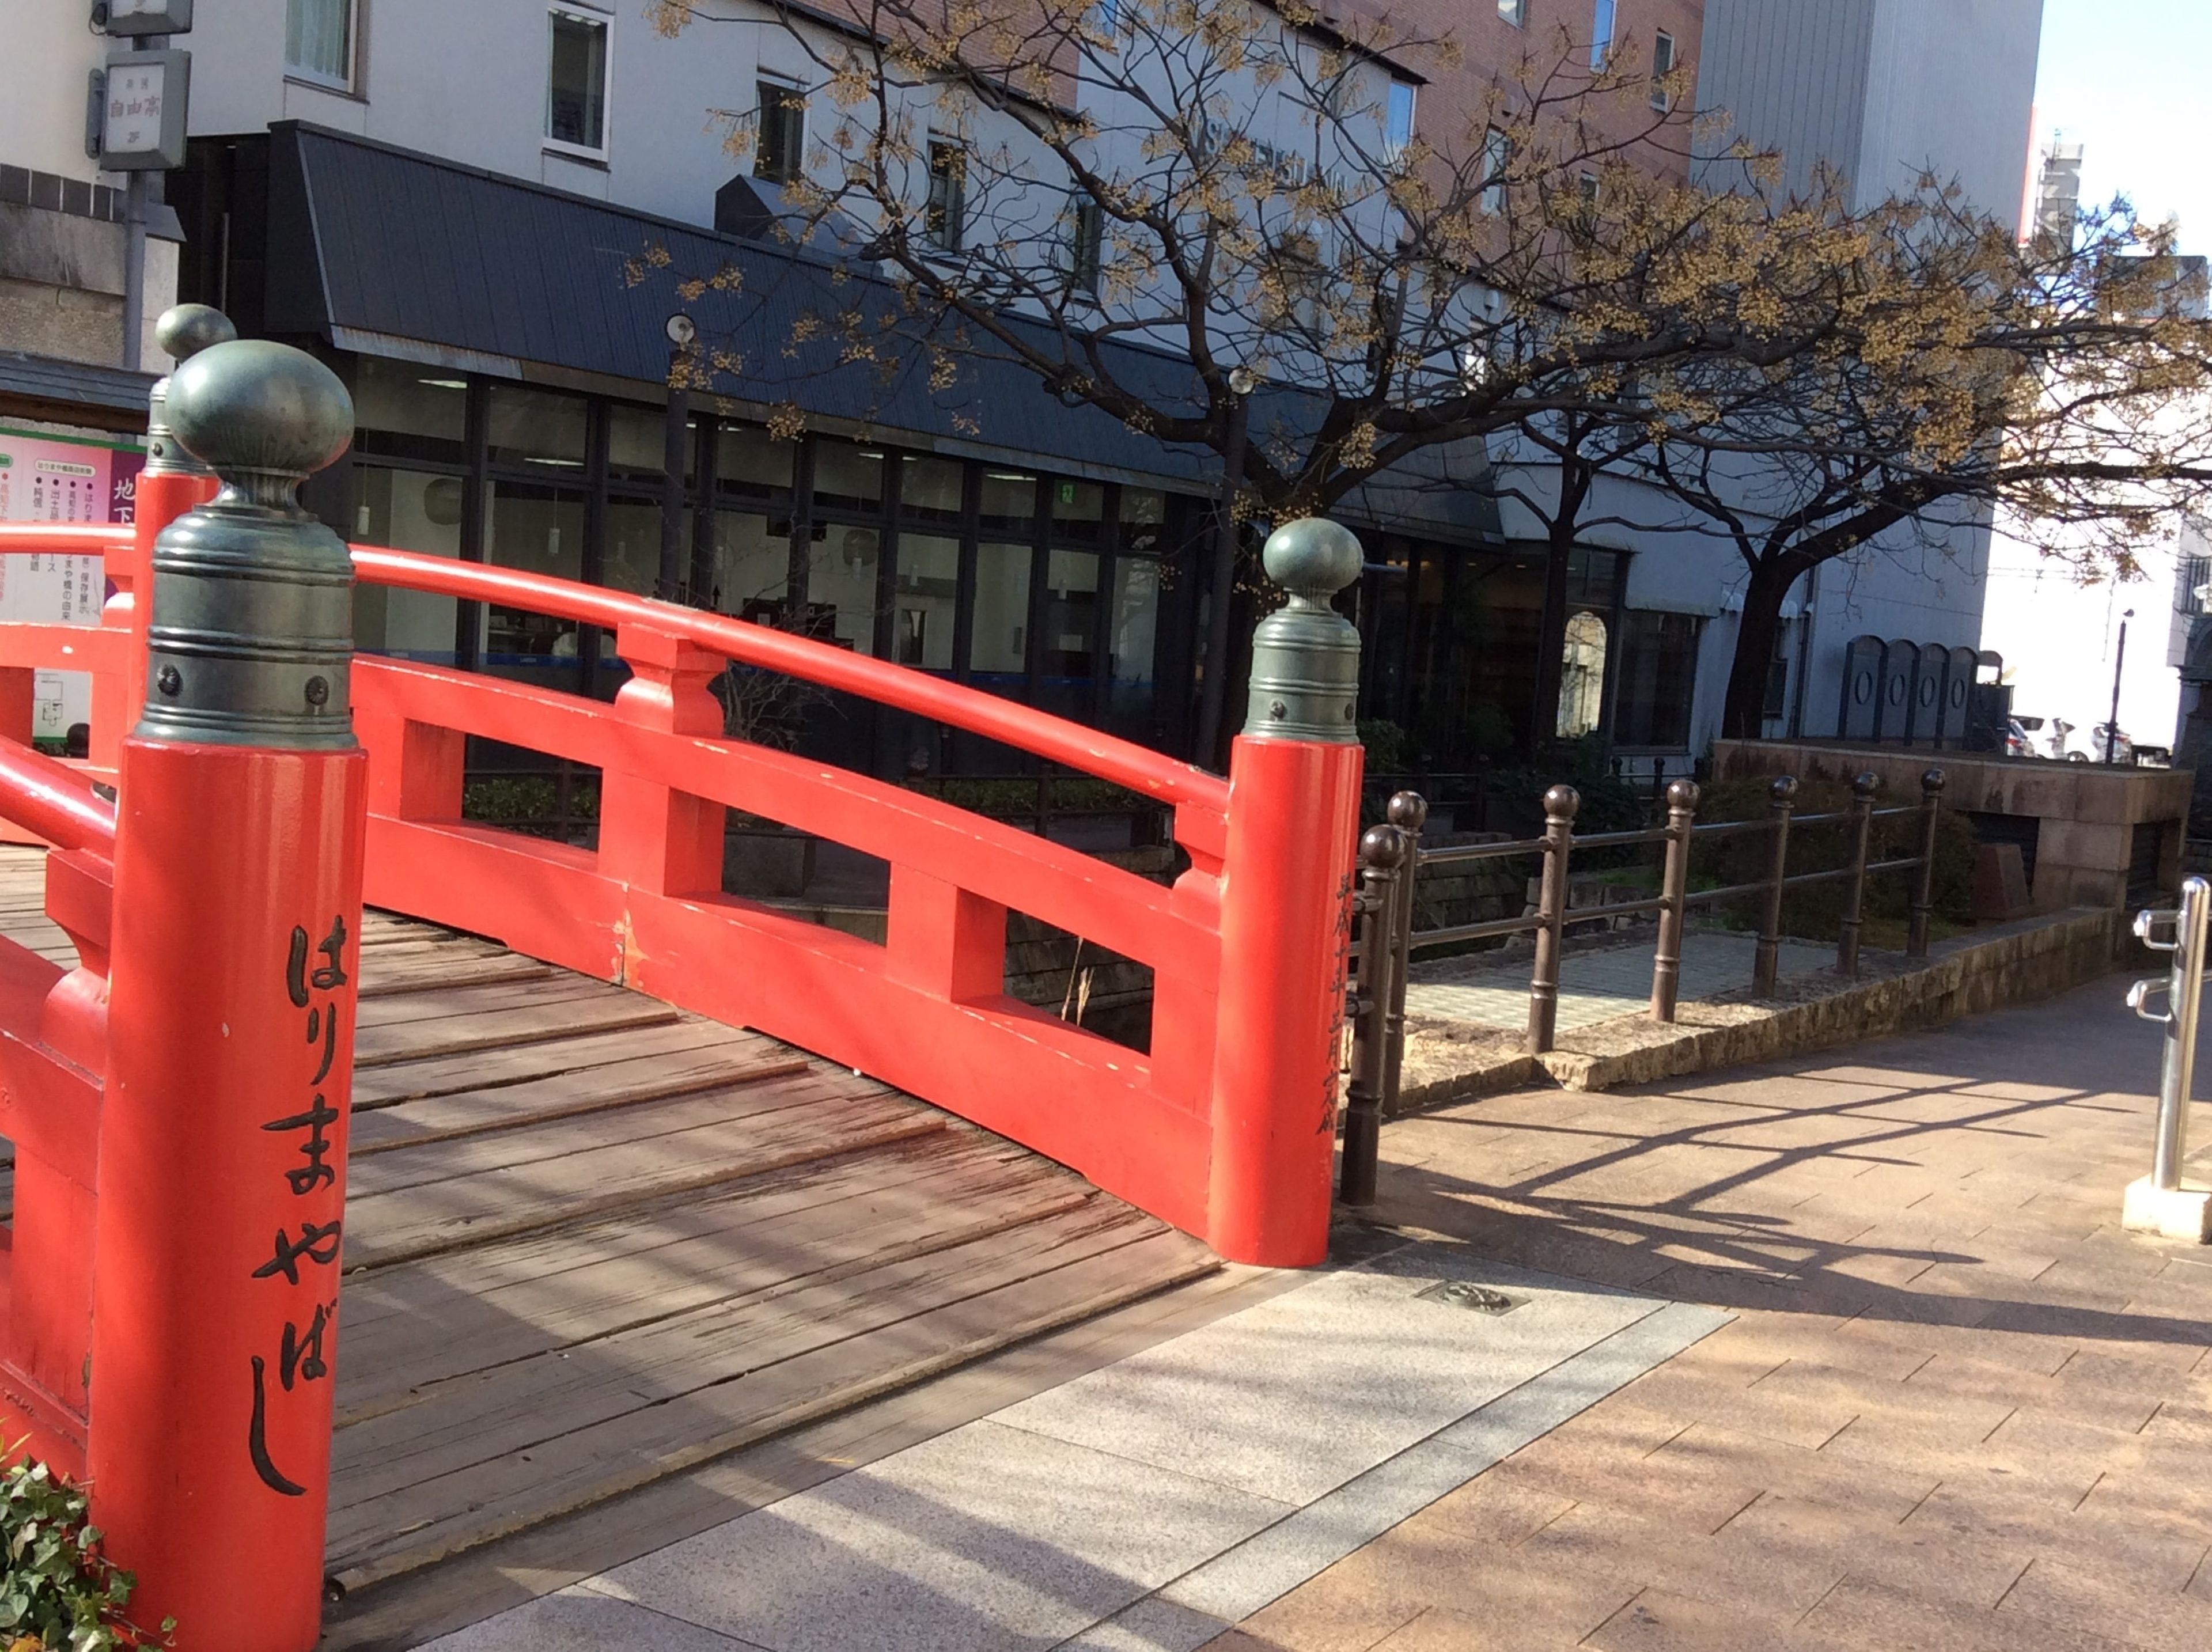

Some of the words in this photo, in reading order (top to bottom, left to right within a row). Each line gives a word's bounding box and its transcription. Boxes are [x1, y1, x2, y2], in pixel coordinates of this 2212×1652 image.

[110, 96, 160, 118] 自由亭
[114, 478, 135, 525] 地下
[61, 554, 74, 621] まや橋の由来
[249, 915, 348, 1496] はりまやばし
